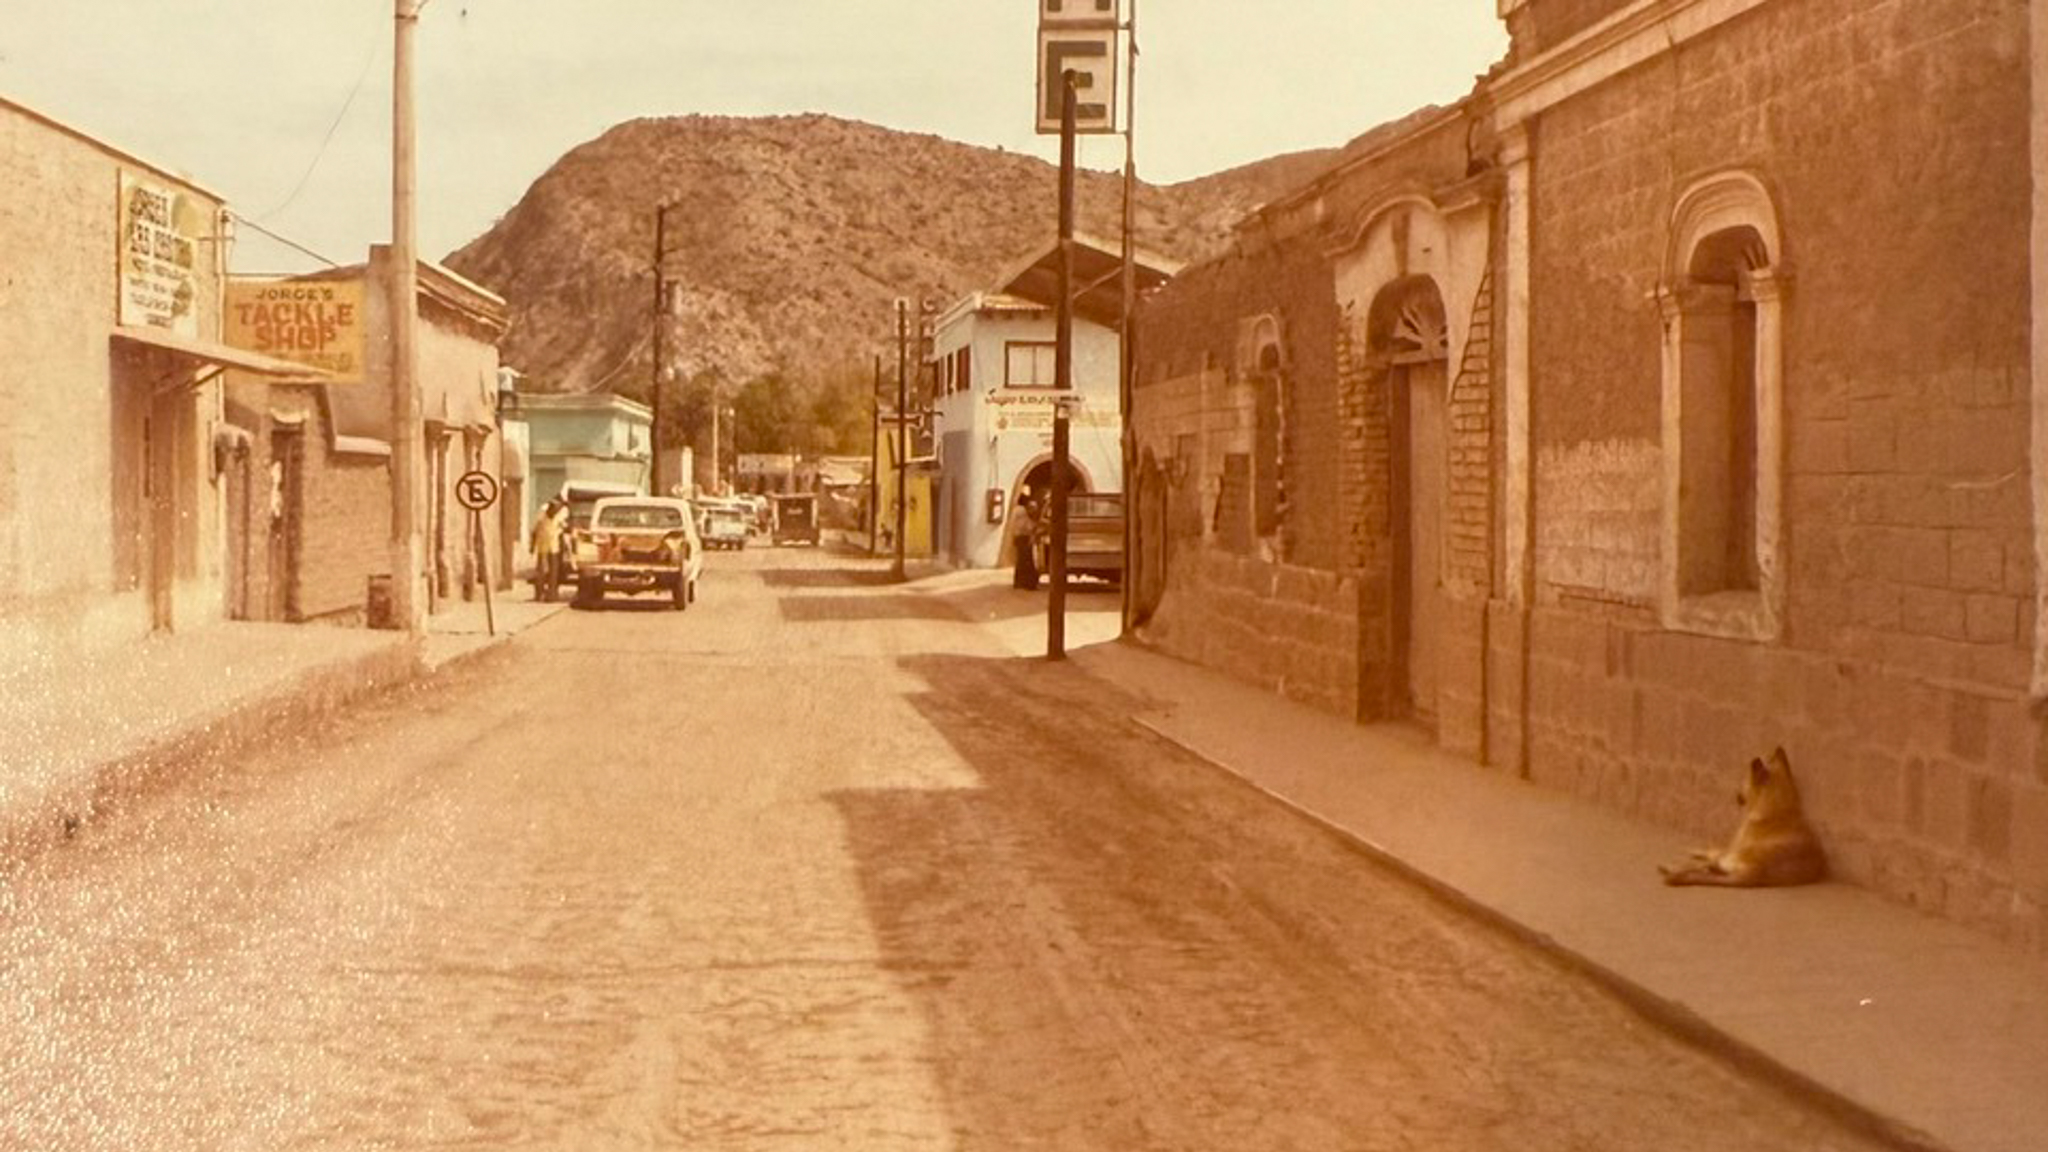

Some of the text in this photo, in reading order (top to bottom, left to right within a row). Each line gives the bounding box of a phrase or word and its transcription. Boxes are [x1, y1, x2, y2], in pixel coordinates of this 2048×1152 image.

[1045, 0, 1108, 120] E
[256, 287, 333, 301] JORGE'S
[234, 302, 355, 326] TACKLE
[254, 323, 336, 351] SHOP
